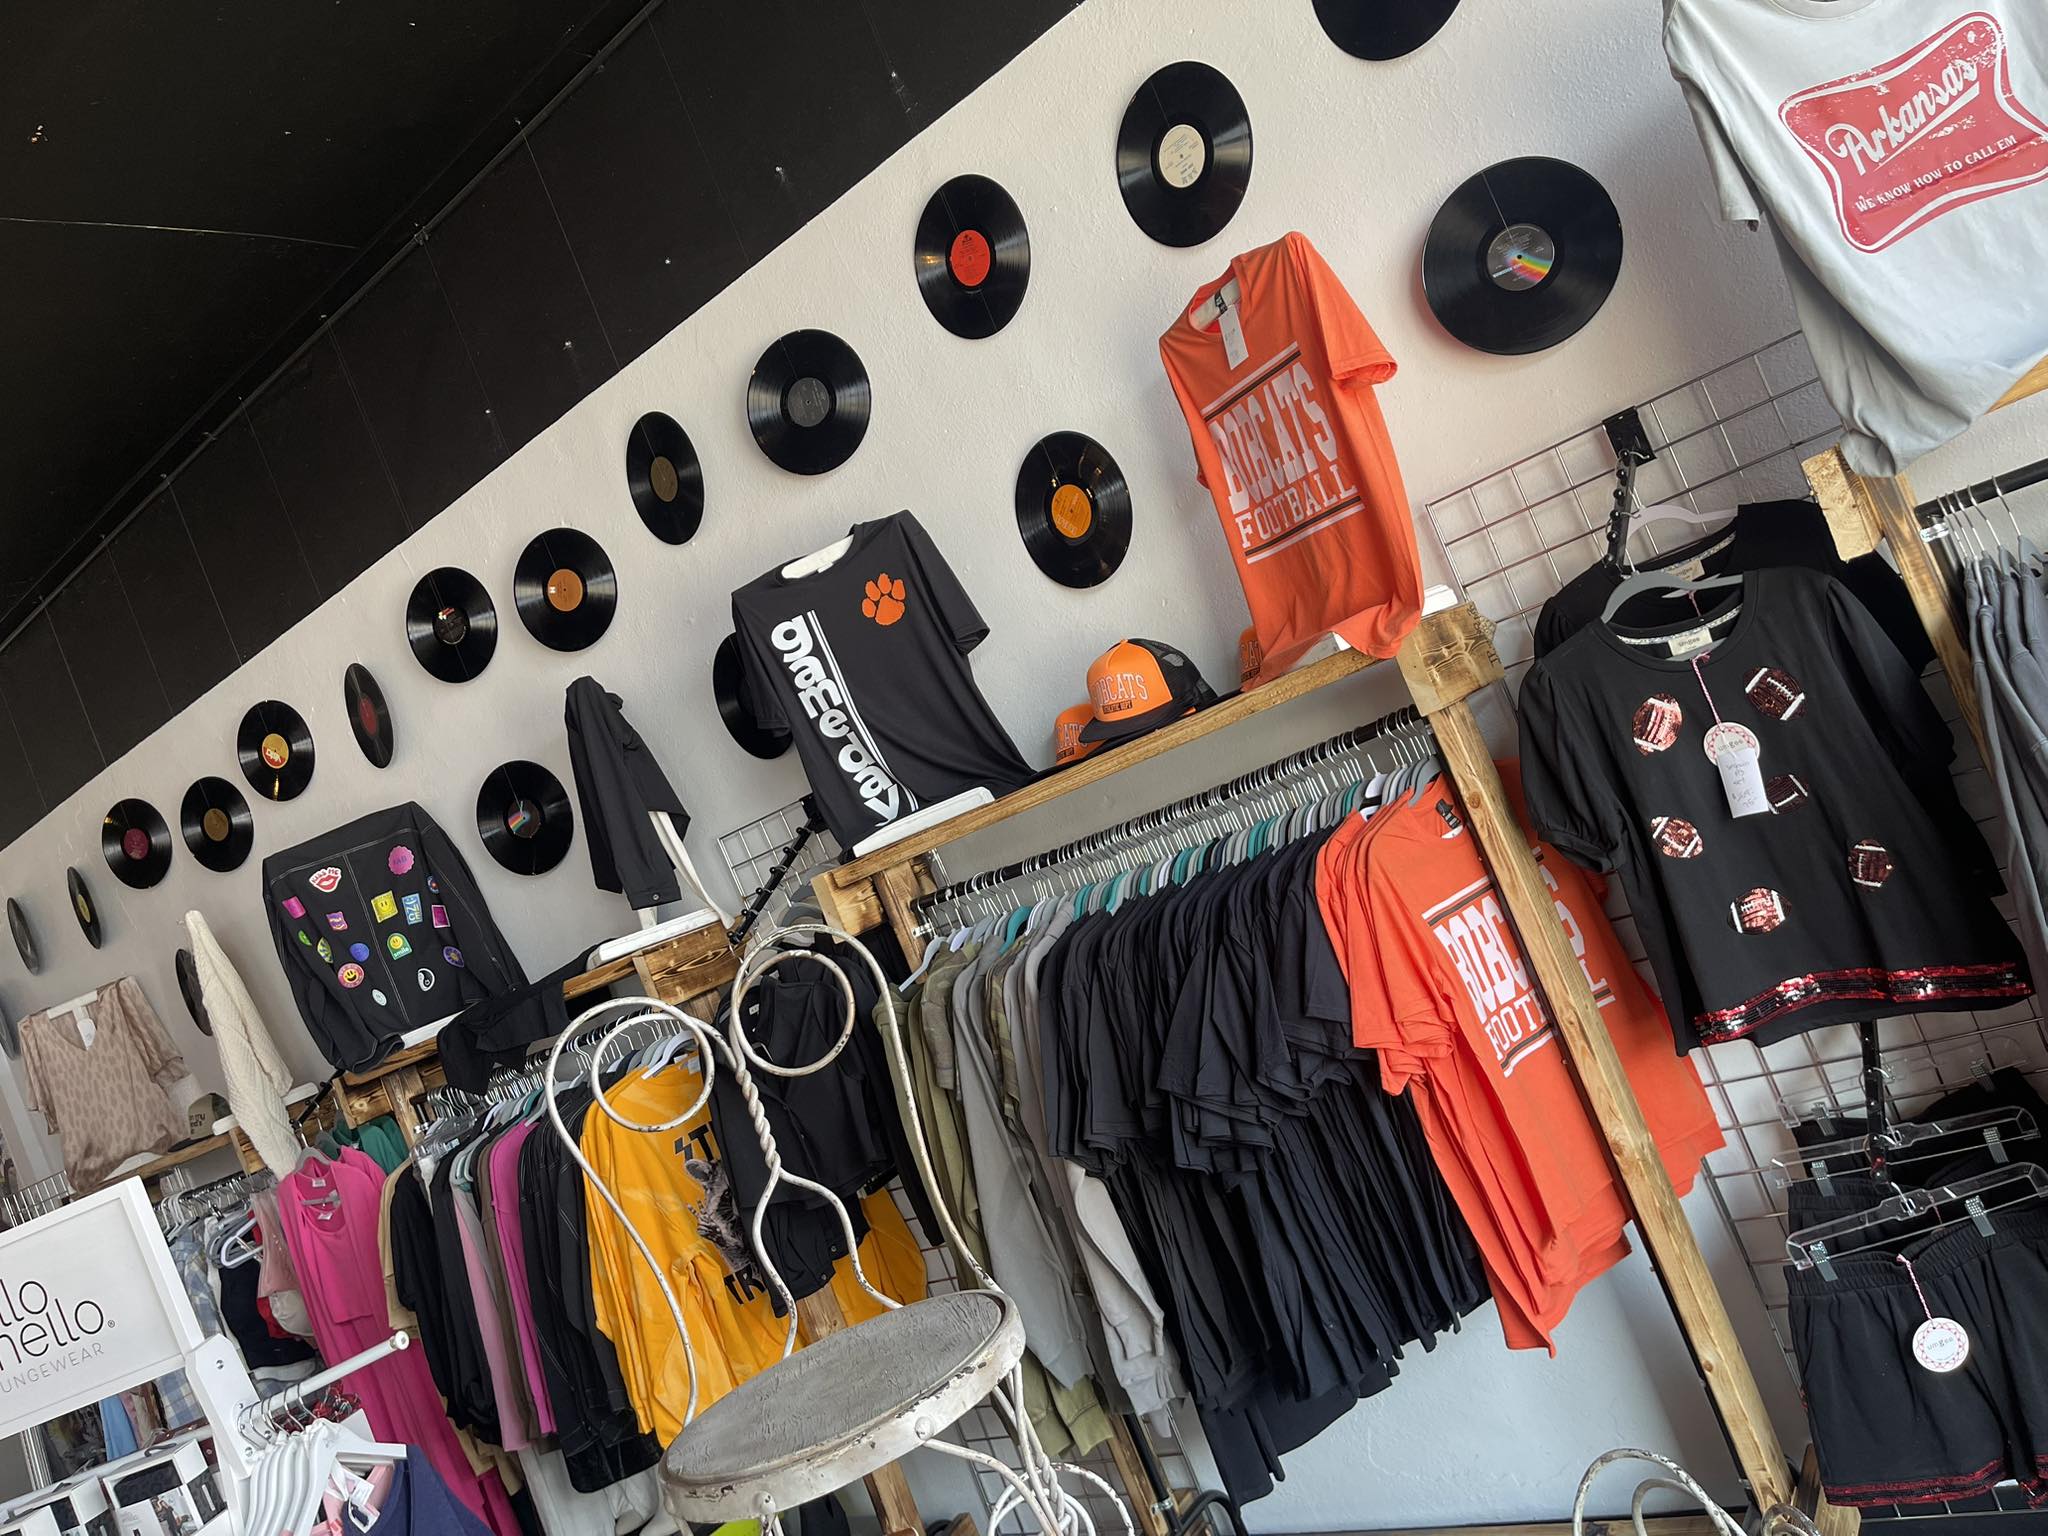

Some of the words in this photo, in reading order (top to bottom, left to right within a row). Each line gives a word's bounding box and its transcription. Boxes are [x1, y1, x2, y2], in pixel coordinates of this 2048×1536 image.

[1825, 59, 1977, 176] Arkansas
[1855, 195, 1877, 212] WE
[1876, 182, 1913, 204] KNOW
[1913, 169, 1943, 188] HOW
[1944, 160, 1963, 175] TO
[1965, 145, 1997, 165] CALL
[1208, 362, 1337, 515] BOBCATS
[1235, 464, 1358, 548] FOOTBALL
[771, 615, 850, 739] game
[838, 731, 900, 827] day
[1433, 895, 1529, 1025] BOBC
[1484, 990, 1547, 1061] FOOT
[0, 1342, 104, 1393] UNGEWEAR
